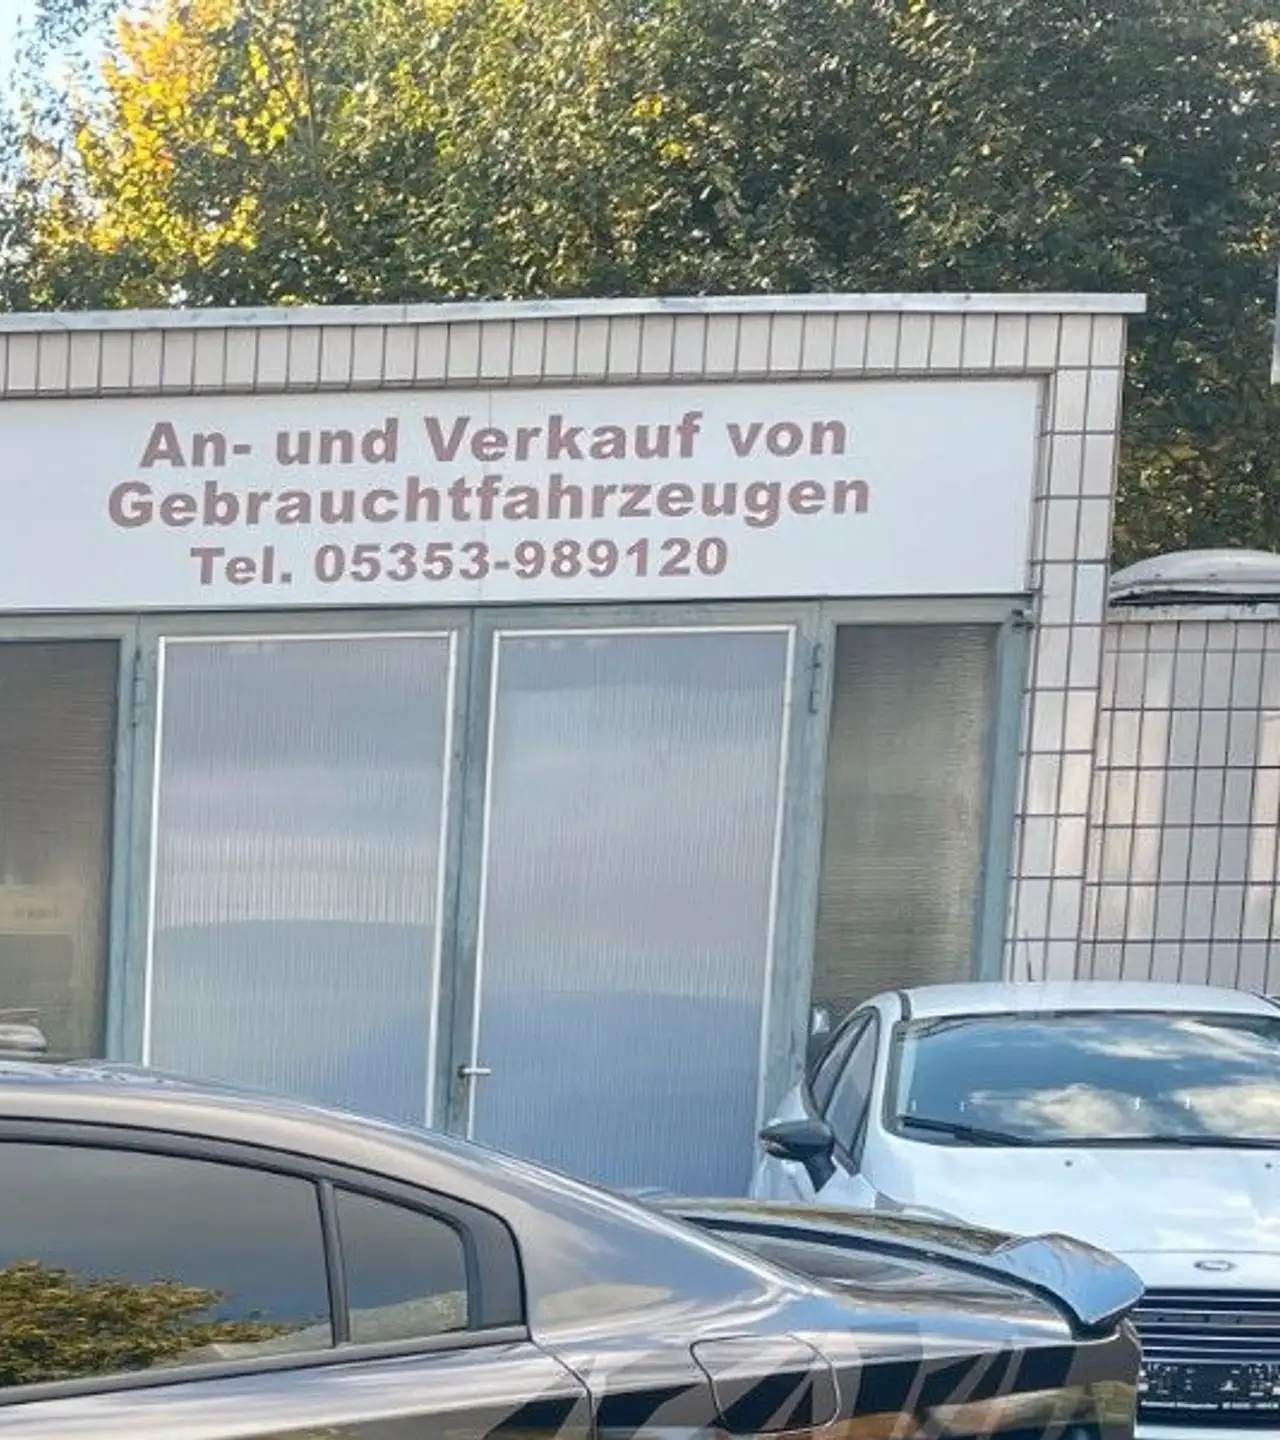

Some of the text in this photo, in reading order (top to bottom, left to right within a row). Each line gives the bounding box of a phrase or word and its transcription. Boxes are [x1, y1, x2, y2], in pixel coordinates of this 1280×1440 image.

[140, 411, 846, 468] An- und Verkauf von
[107, 473, 871, 528] Gebrauchtfahrzeugen
[190, 536, 730, 586] Tel. 05353-989120
